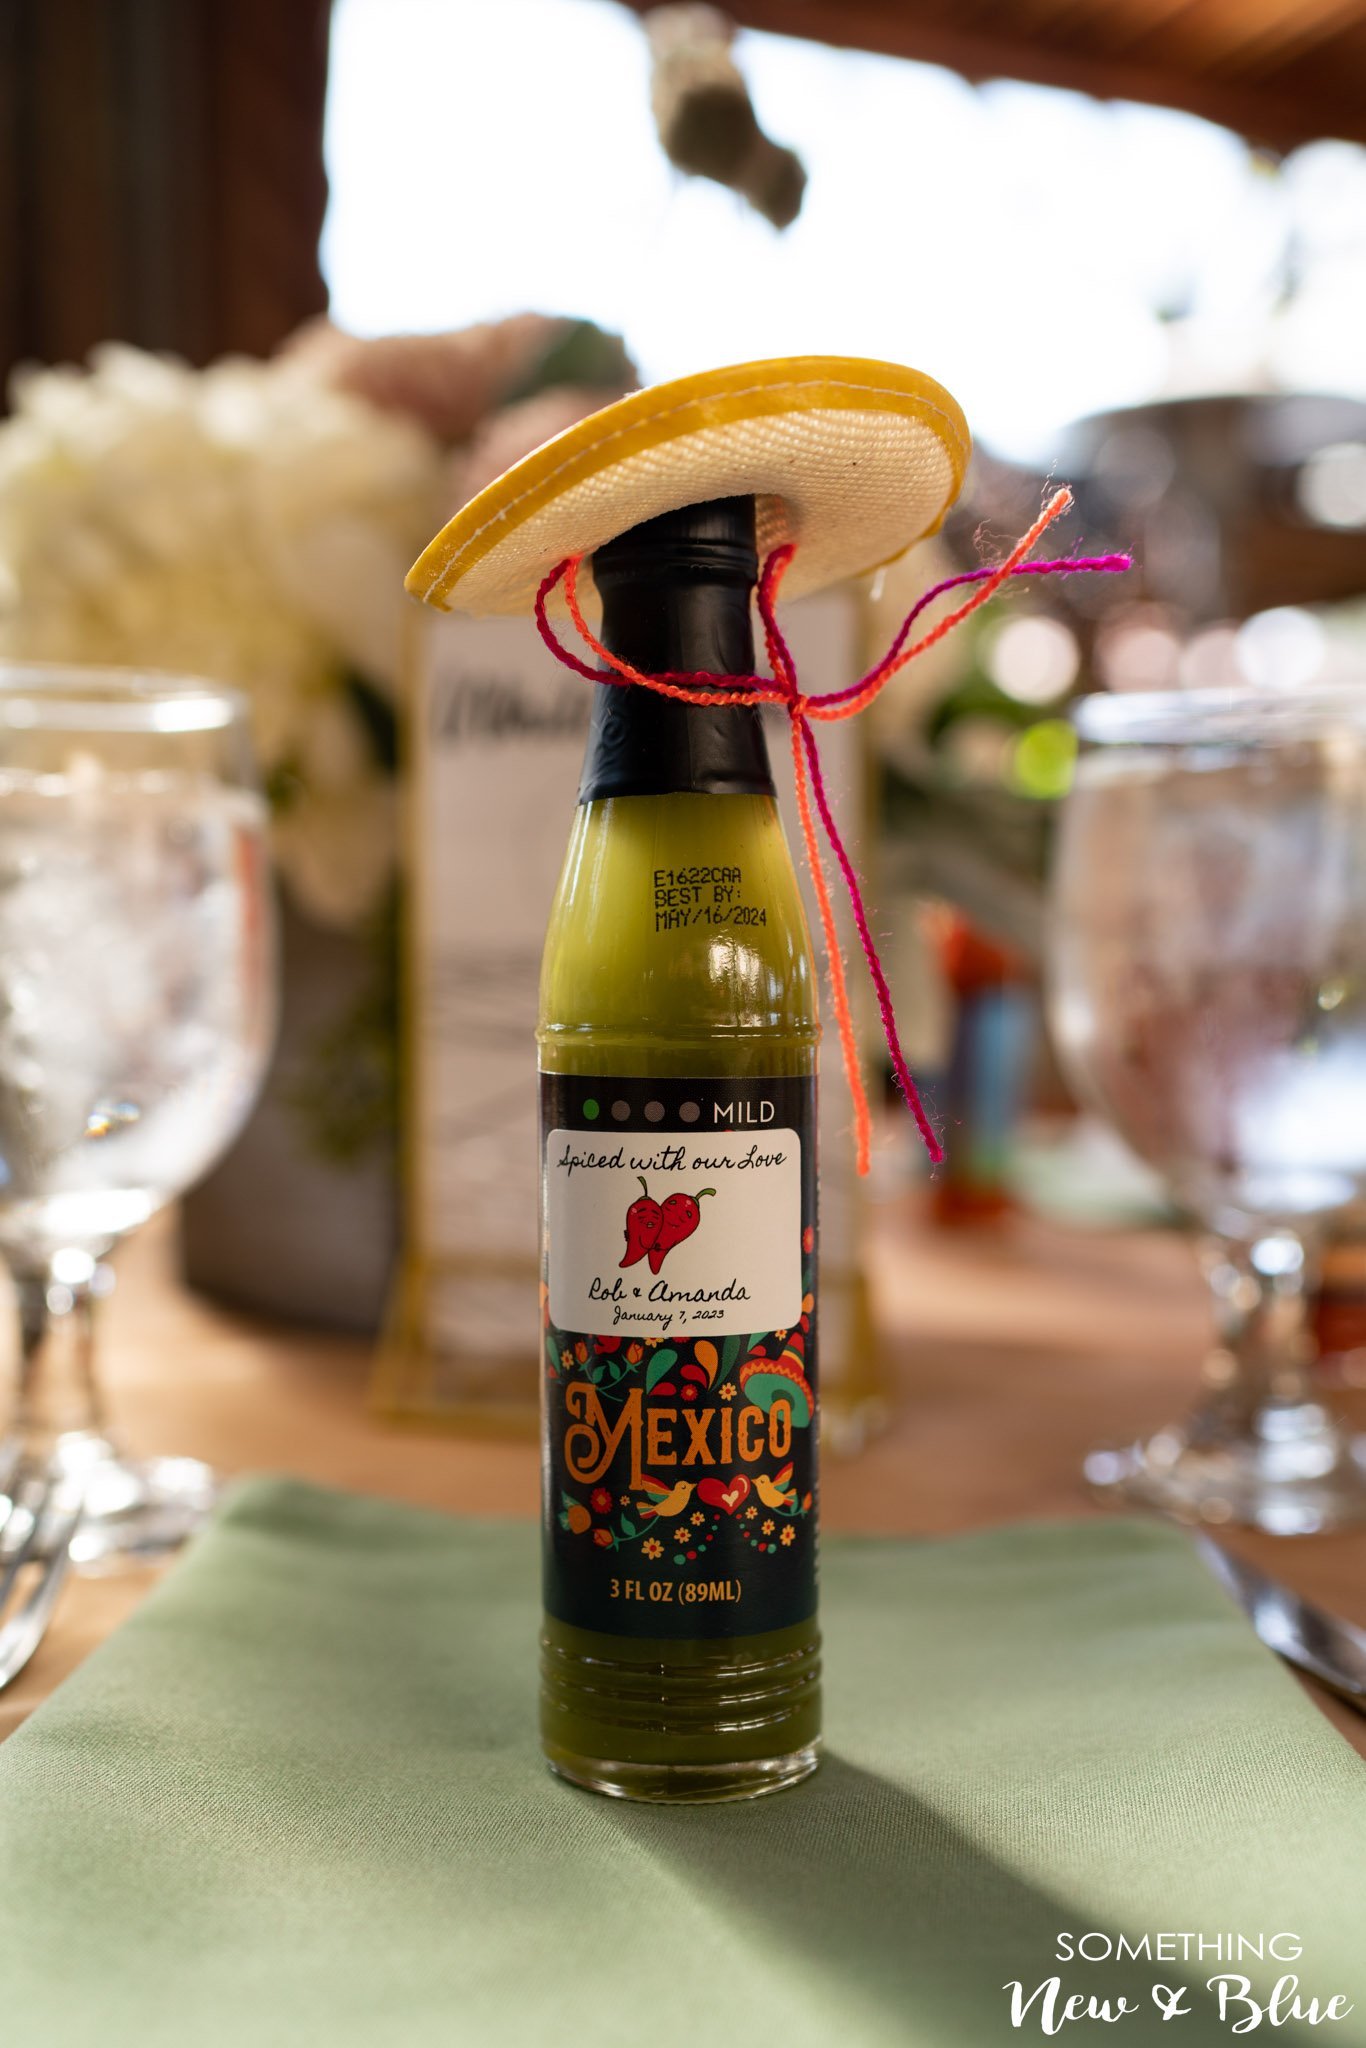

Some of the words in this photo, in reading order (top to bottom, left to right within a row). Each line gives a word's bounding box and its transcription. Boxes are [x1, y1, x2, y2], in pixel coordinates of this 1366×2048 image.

[653, 867, 742, 888] E1622CAA
[654, 886, 703, 909] BEST
[713, 885, 741, 903] BY:
[655, 905, 767, 933] MAY/16/2024
[713, 1100, 775, 1124] MILD
[557, 1144, 626, 1177] Spiced
[629, 1145, 687, 1172] with
[692, 1153, 738, 1170] our
[736, 1144, 788, 1170] Love
[588, 1277, 627, 1301] Rob
[647, 1278, 752, 1303] Amanda
[612, 1305, 673, 1331] January
[678, 1310, 689, 1325] 7,
[691, 1309, 725, 1321] 2023
[609, 1578, 621, 1599] 3
[624, 1579, 646, 1602] FL
[649, 1581, 674, 1603] OZ
[677, 1578, 743, 1606] (89ML)
